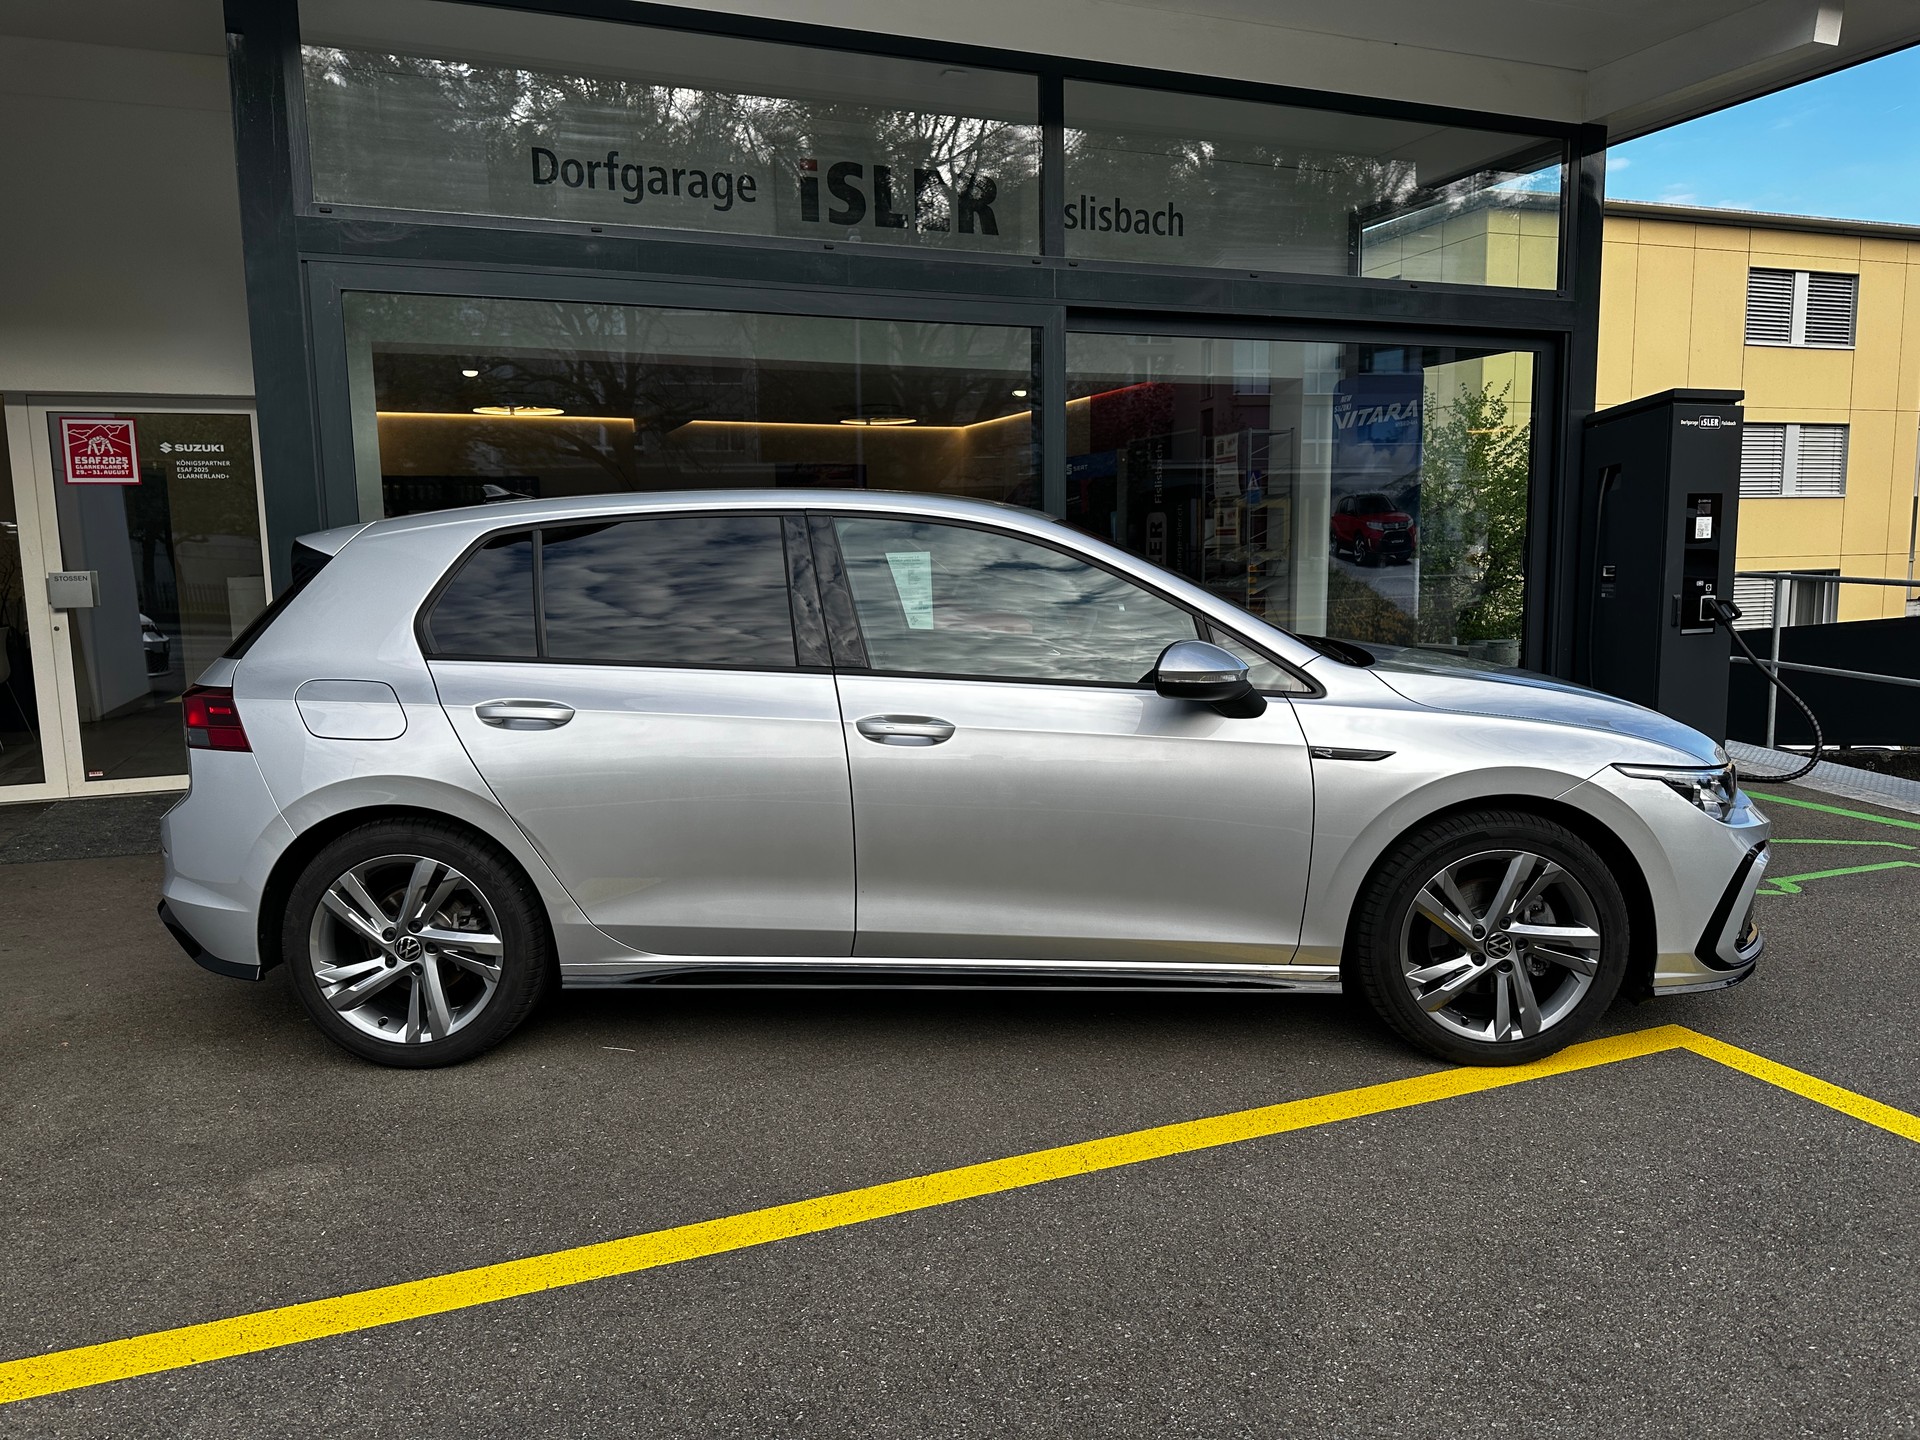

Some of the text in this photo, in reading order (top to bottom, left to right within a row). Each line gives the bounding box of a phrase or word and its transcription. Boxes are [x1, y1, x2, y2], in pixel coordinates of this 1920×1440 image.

[531, 146, 758, 212] Dorfgarage
[1063, 194, 1184, 237] slisbach
[1333, 399, 1419, 430] VITARA
[174, 443, 225, 452] SUZUKI
[74, 456, 129, 465] ESAF 2025
[175, 459, 231, 467] KÖNIGSPARTNER
